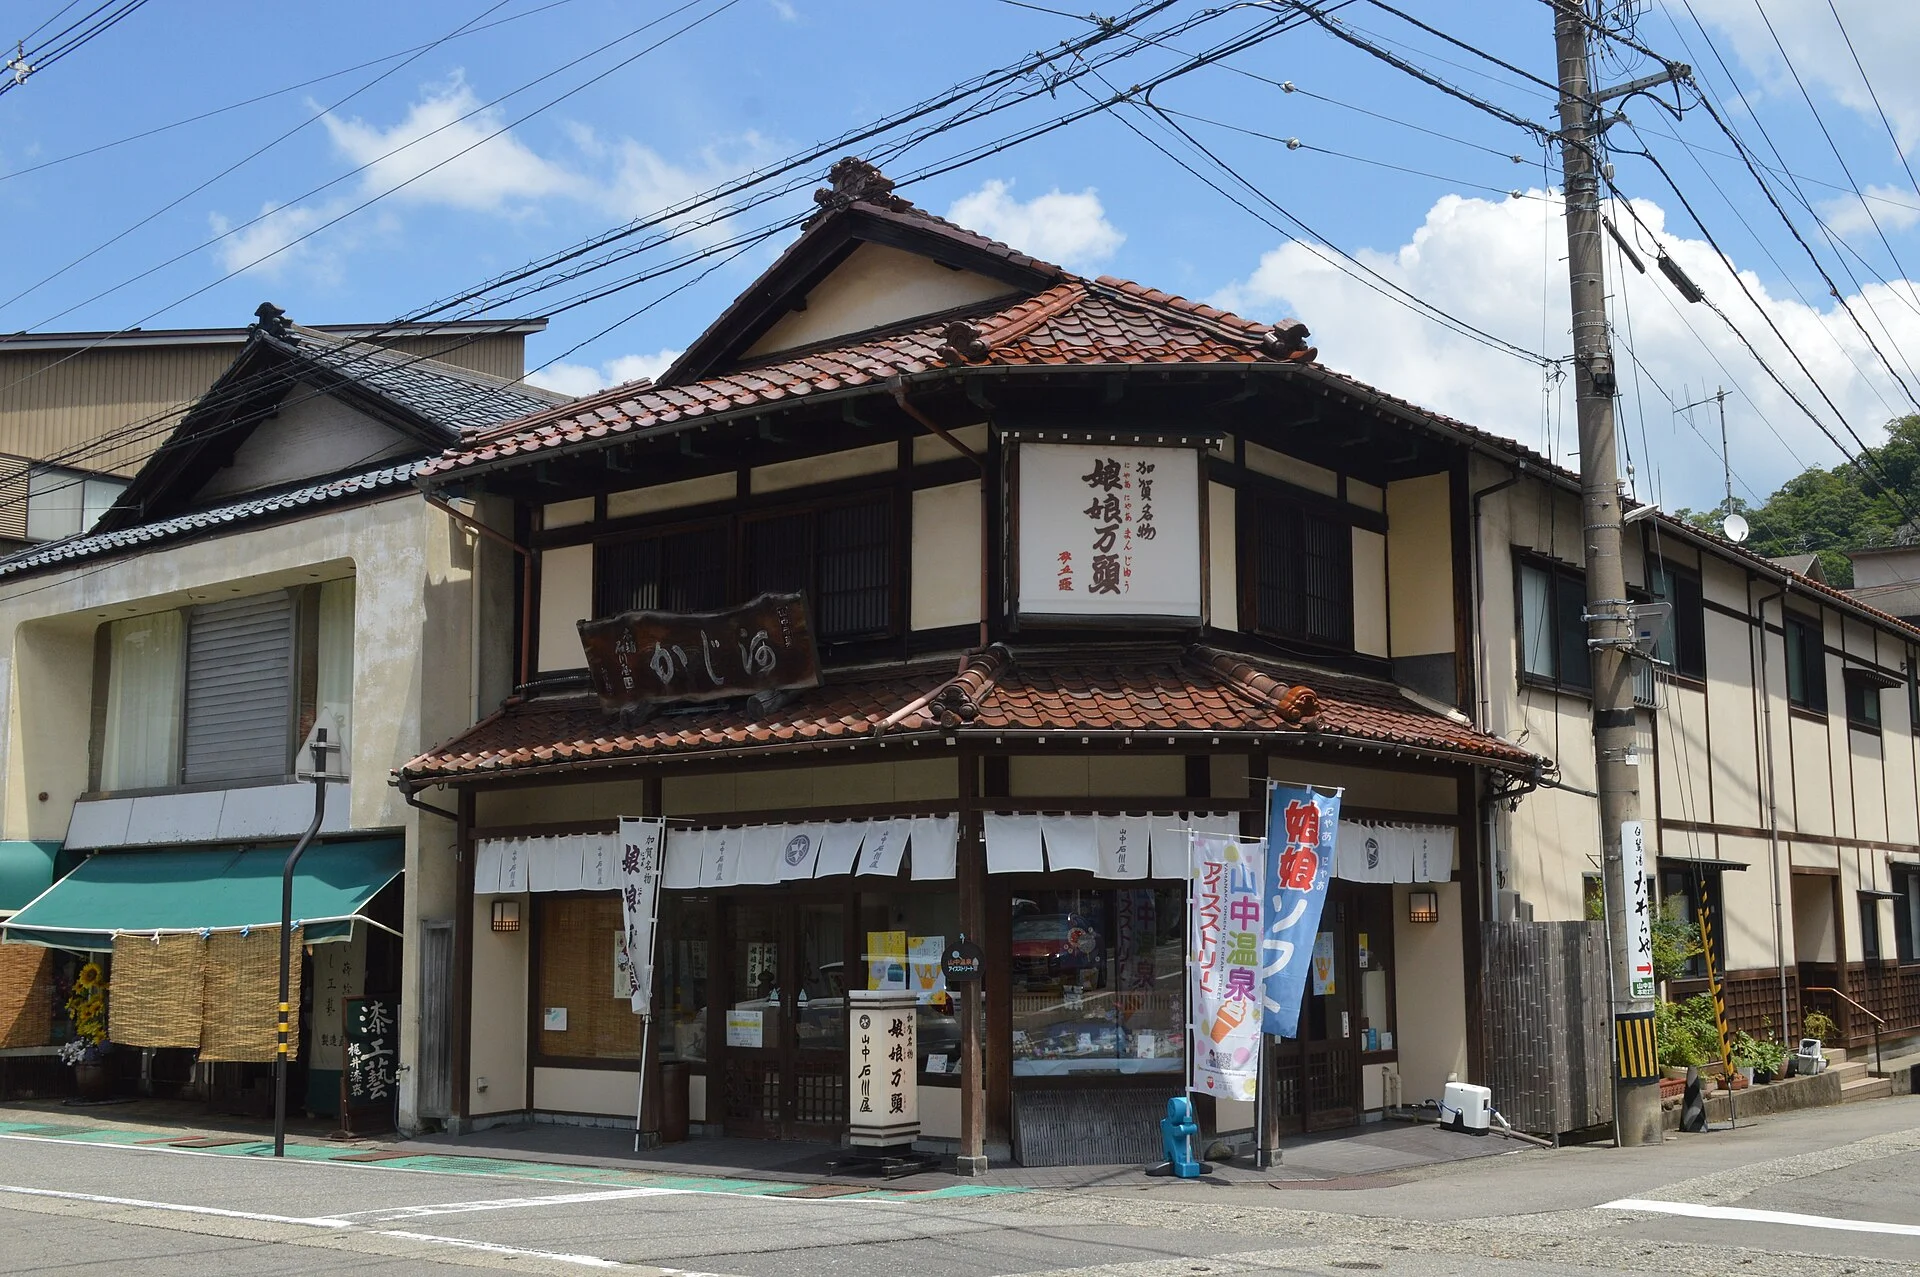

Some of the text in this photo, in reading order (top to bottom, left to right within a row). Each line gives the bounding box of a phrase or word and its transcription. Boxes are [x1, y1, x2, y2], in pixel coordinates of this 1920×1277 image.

[1081, 458, 1124, 595] 娘娘万頭
[1136, 460, 1157, 541] 加賀名物
[643, 836, 655, 885] 加賀名物
[715, 839, 727, 881] 山中石川屋
[868, 830, 889, 869] 山中石川屋
[1114, 828, 1130, 874] 山中石川屋
[1197, 861, 1223, 999] アイスストリート
[1224, 866, 1260, 1003] 山中温泉
[1634, 870, 1651, 959] たわらや
[360, 1000, 395, 1100] 漆工藝
[858, 1034, 873, 1113] 山中石川屋
[888, 1018, 904, 1114] 娘娘万頭
[906, 1012, 914, 1060] 加賀名物
